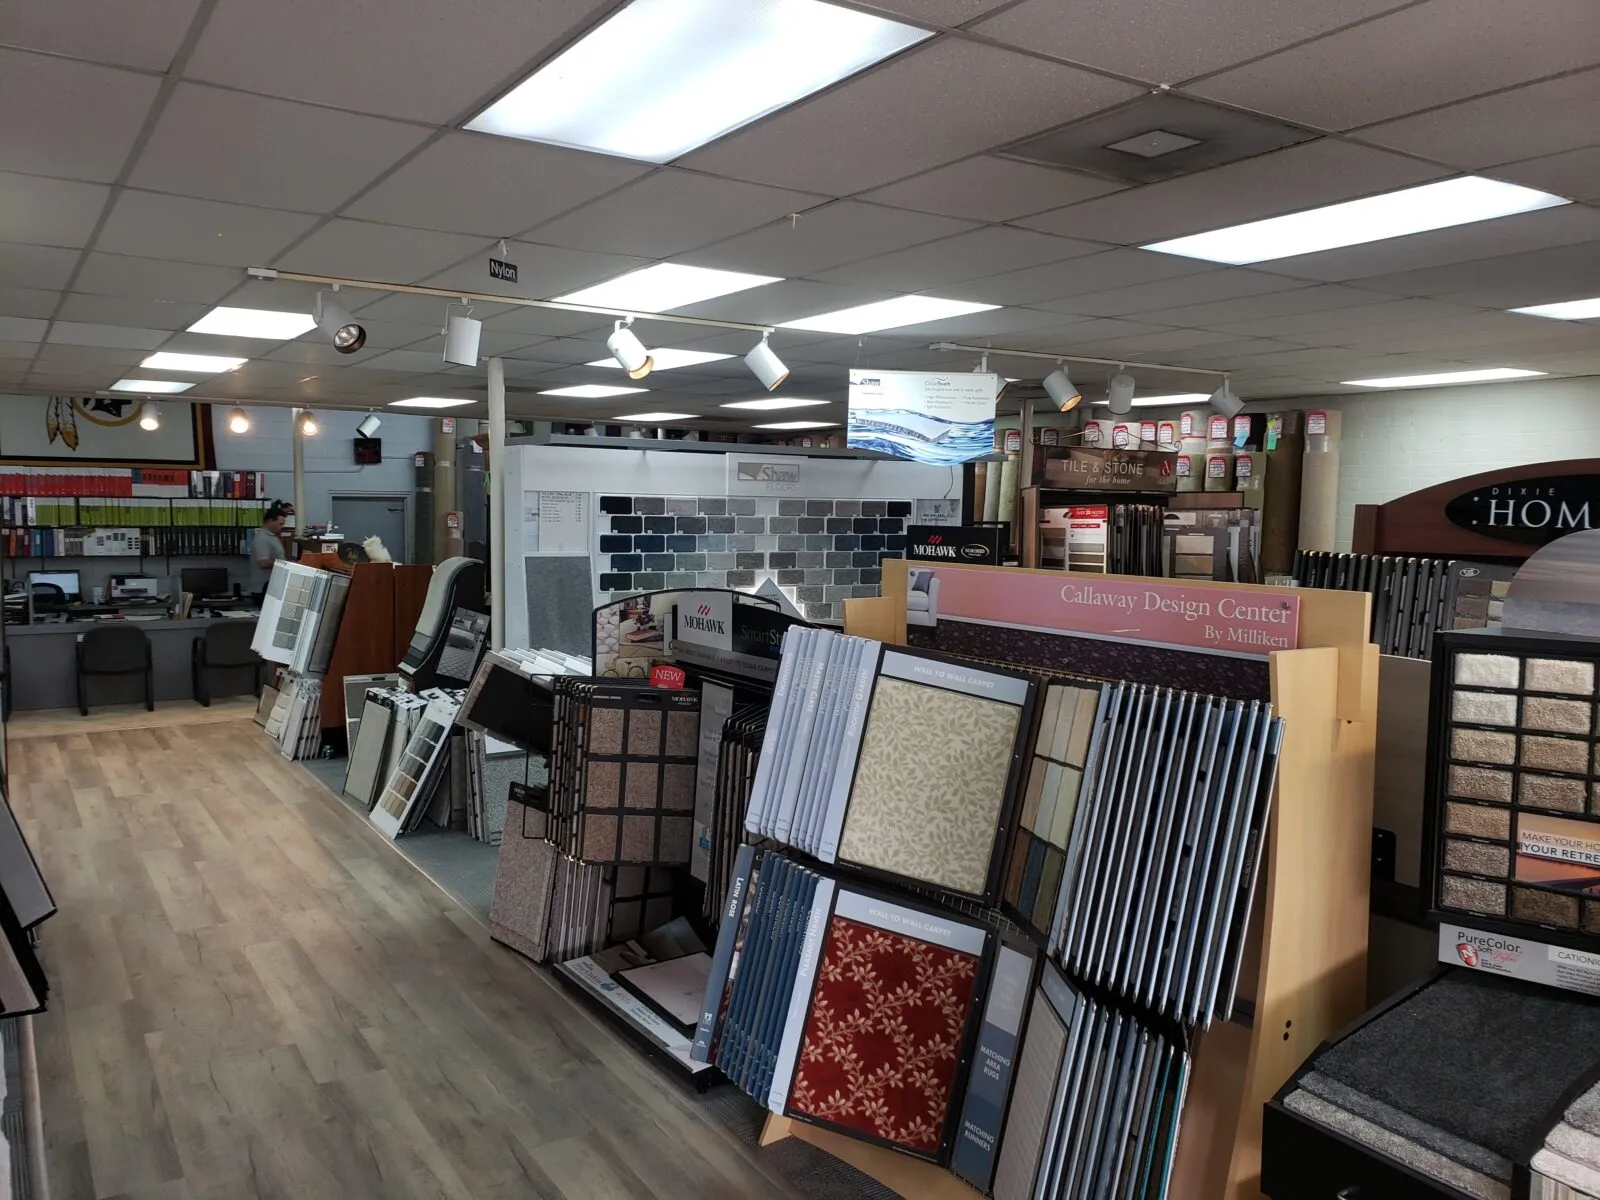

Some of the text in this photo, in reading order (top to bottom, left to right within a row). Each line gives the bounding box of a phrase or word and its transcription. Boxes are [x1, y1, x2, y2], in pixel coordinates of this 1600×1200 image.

[490, 261, 516, 279] Nylon
[762, 465, 798, 482] Shaw
[1062, 460, 1144, 475] TILE & STONE
[766, 482, 800, 492] FLOORS
[1084, 475, 1132, 486] for the home
[1492, 487, 1556, 496] DIXIE
[1487, 499, 1593, 529] HOM
[913, 544, 957, 558] MOHAWK
[1060, 585, 1291, 625] Callaway Design Center
[684, 615, 725, 635] MOHAWK
[1204, 625, 1289, 648] By Milliken
[655, 669, 681, 681] NEW
[914, 665, 995, 689] WALL TO WALL CARPET
[806, 690, 818, 713] CLASS
[1522, 832, 1600, 852] MAKE YOUR HO
[1523, 843, 1600, 863] YOUR RETRE
[727, 876, 744, 918] LATIN ROSE
[808, 907, 823, 936] HAVEN
[869, 908, 952, 937] WALL TO WALL CARPET
[1457, 931, 1521, 953] PureColor
[1477, 945, 1492, 955] Soft
[980, 1045, 1011, 1066] MATCHING
[985, 1058, 1001, 1071] AREA
[983, 1067, 1000, 1081] RUGS
[964, 1120, 994, 1144] MATCHING
[964, 1131, 991, 1152] RUNNERS
